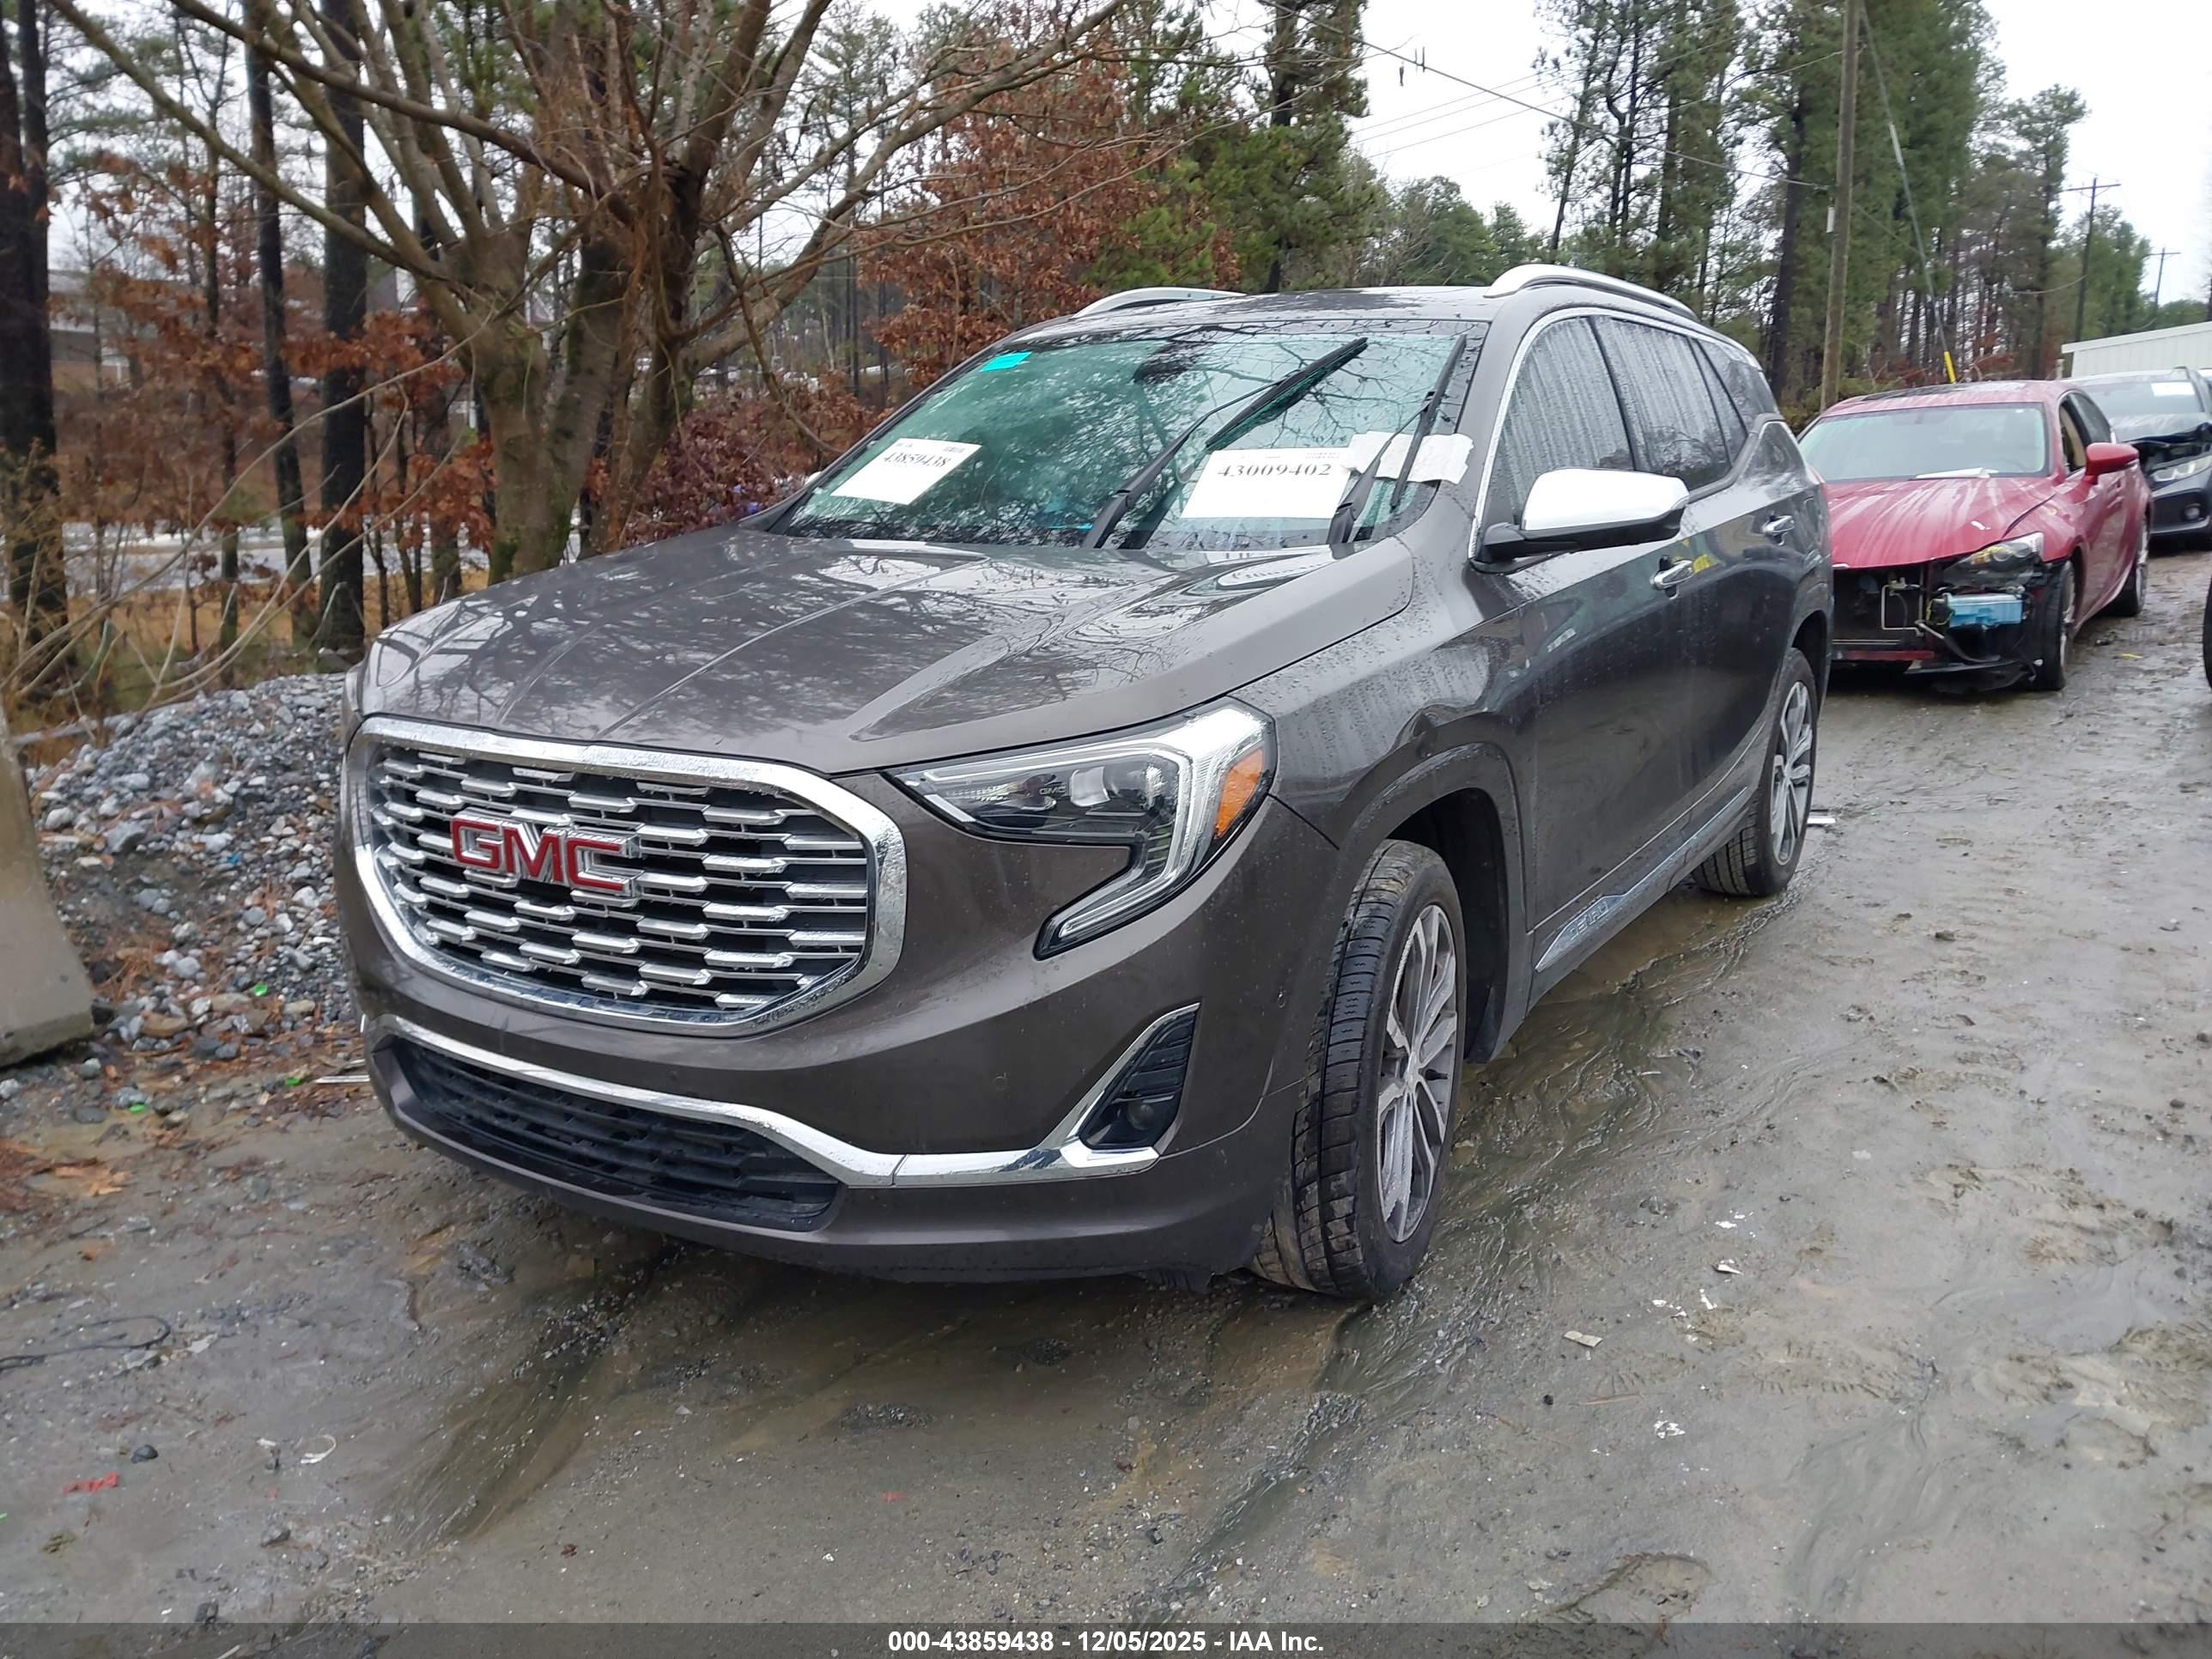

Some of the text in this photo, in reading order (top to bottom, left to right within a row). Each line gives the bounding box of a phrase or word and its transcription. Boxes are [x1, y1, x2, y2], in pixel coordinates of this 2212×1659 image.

[884, 452, 951, 467] 43859438
[1217, 463, 1333, 477] 43009402
[451, 813, 637, 896] GMC
